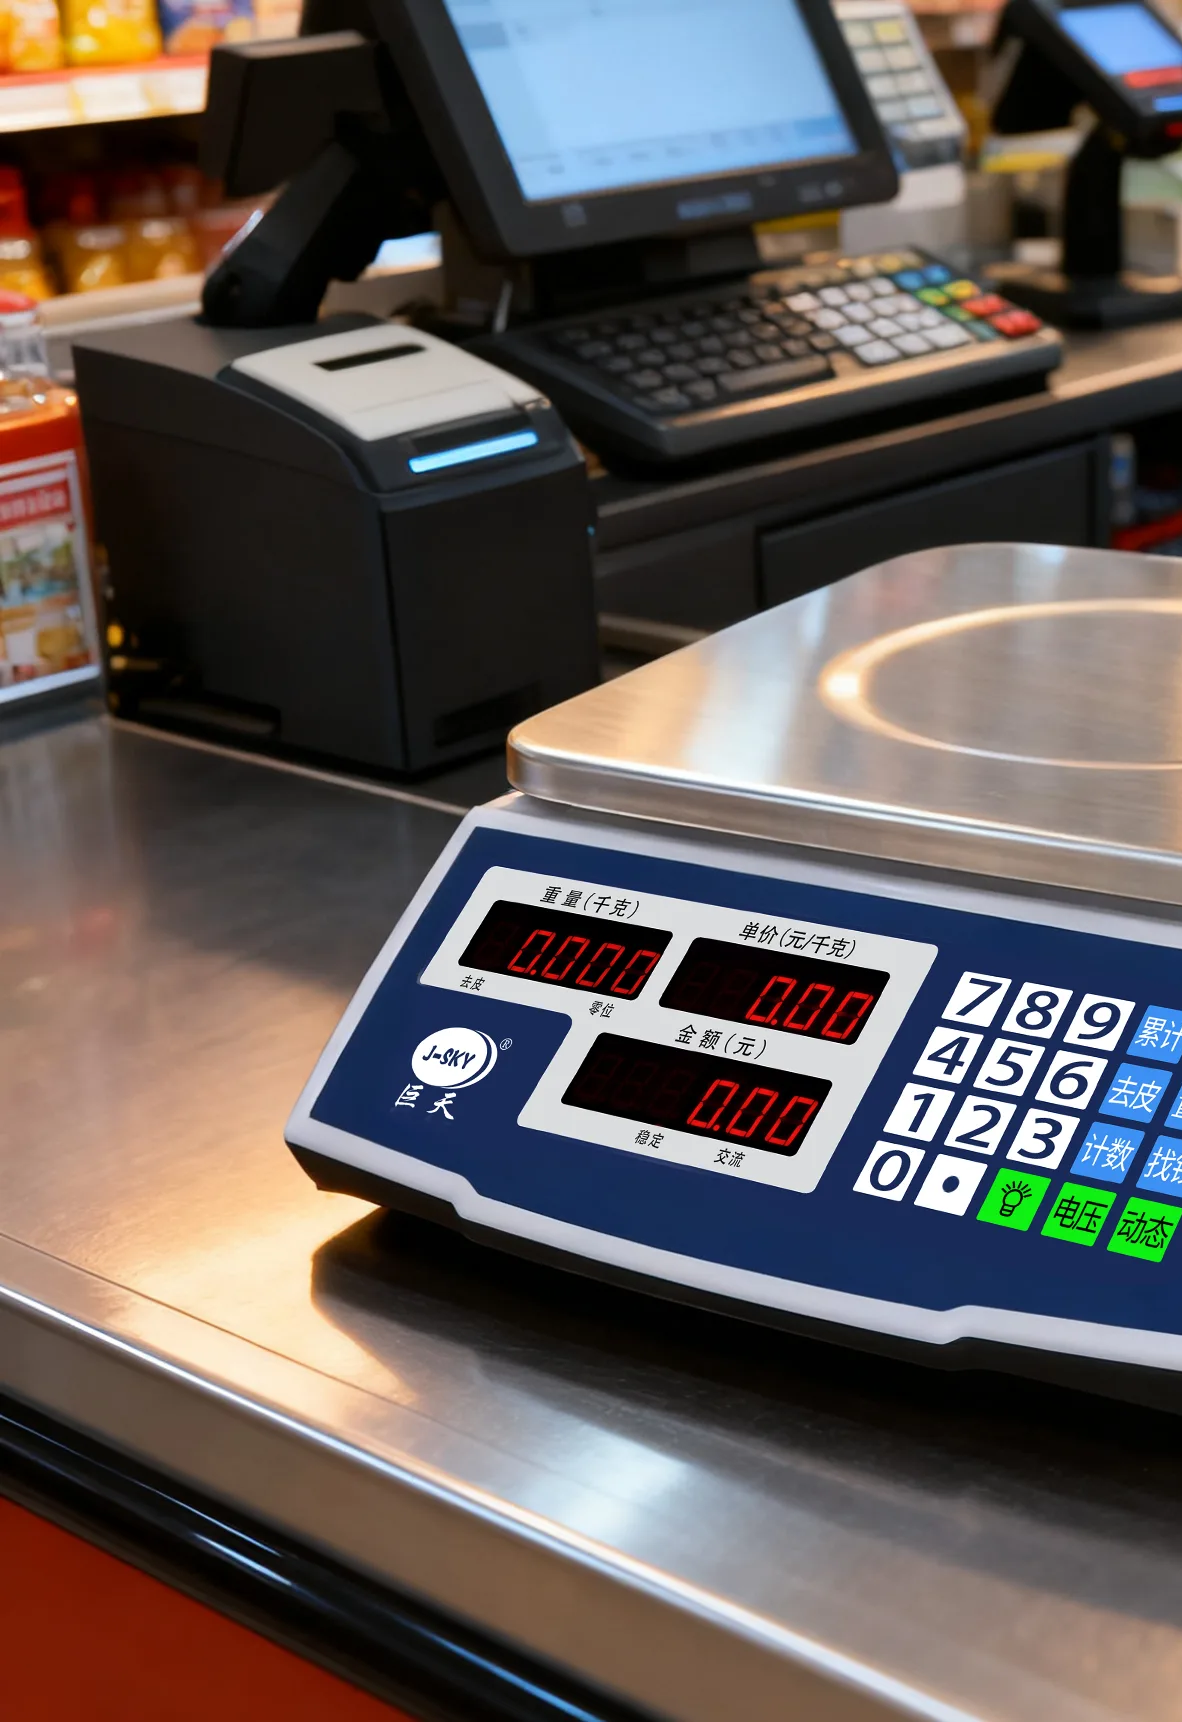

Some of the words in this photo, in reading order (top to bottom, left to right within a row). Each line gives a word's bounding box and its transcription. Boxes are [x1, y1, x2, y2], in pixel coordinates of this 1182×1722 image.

[539, 885, 640, 919] 重量(千克)
[738, 921, 858, 960] 单价(元/千克)
[508, 929, 660, 995] 0.000
[459, 974, 485, 993] 去皮
[589, 1000, 615, 1019] 零位
[745, 976, 874, 1039] 0.00
[956, 978, 1003, 1017] 7
[1016, 991, 1060, 1031] 8
[1077, 1002, 1121, 1040] 9
[422, 1045, 476, 1069] J-SKY
[675, 1024, 769, 1060] 金额(元)
[927, 1037, 970, 1075] 4
[985, 1046, 1033, 1087] 5
[1050, 1061, 1094, 1100] 6
[395, 1083, 457, 1120] 巨天
[687, 1079, 819, 1147] 0.00
[1109, 1076, 1163, 1113] 去皮
[635, 1130, 665, 1150] 稳定
[908, 1093, 936, 1133] 1
[955, 1105, 1002, 1149] 2
[1017, 1118, 1063, 1160] 3
[713, 1148, 746, 1169] 交流
[870, 1150, 911, 1192] 0
[1082, 1133, 1135, 1172] 计数
[1053, 1196, 1108, 1234] 电压
[1117, 1211, 1174, 1249] 动态
